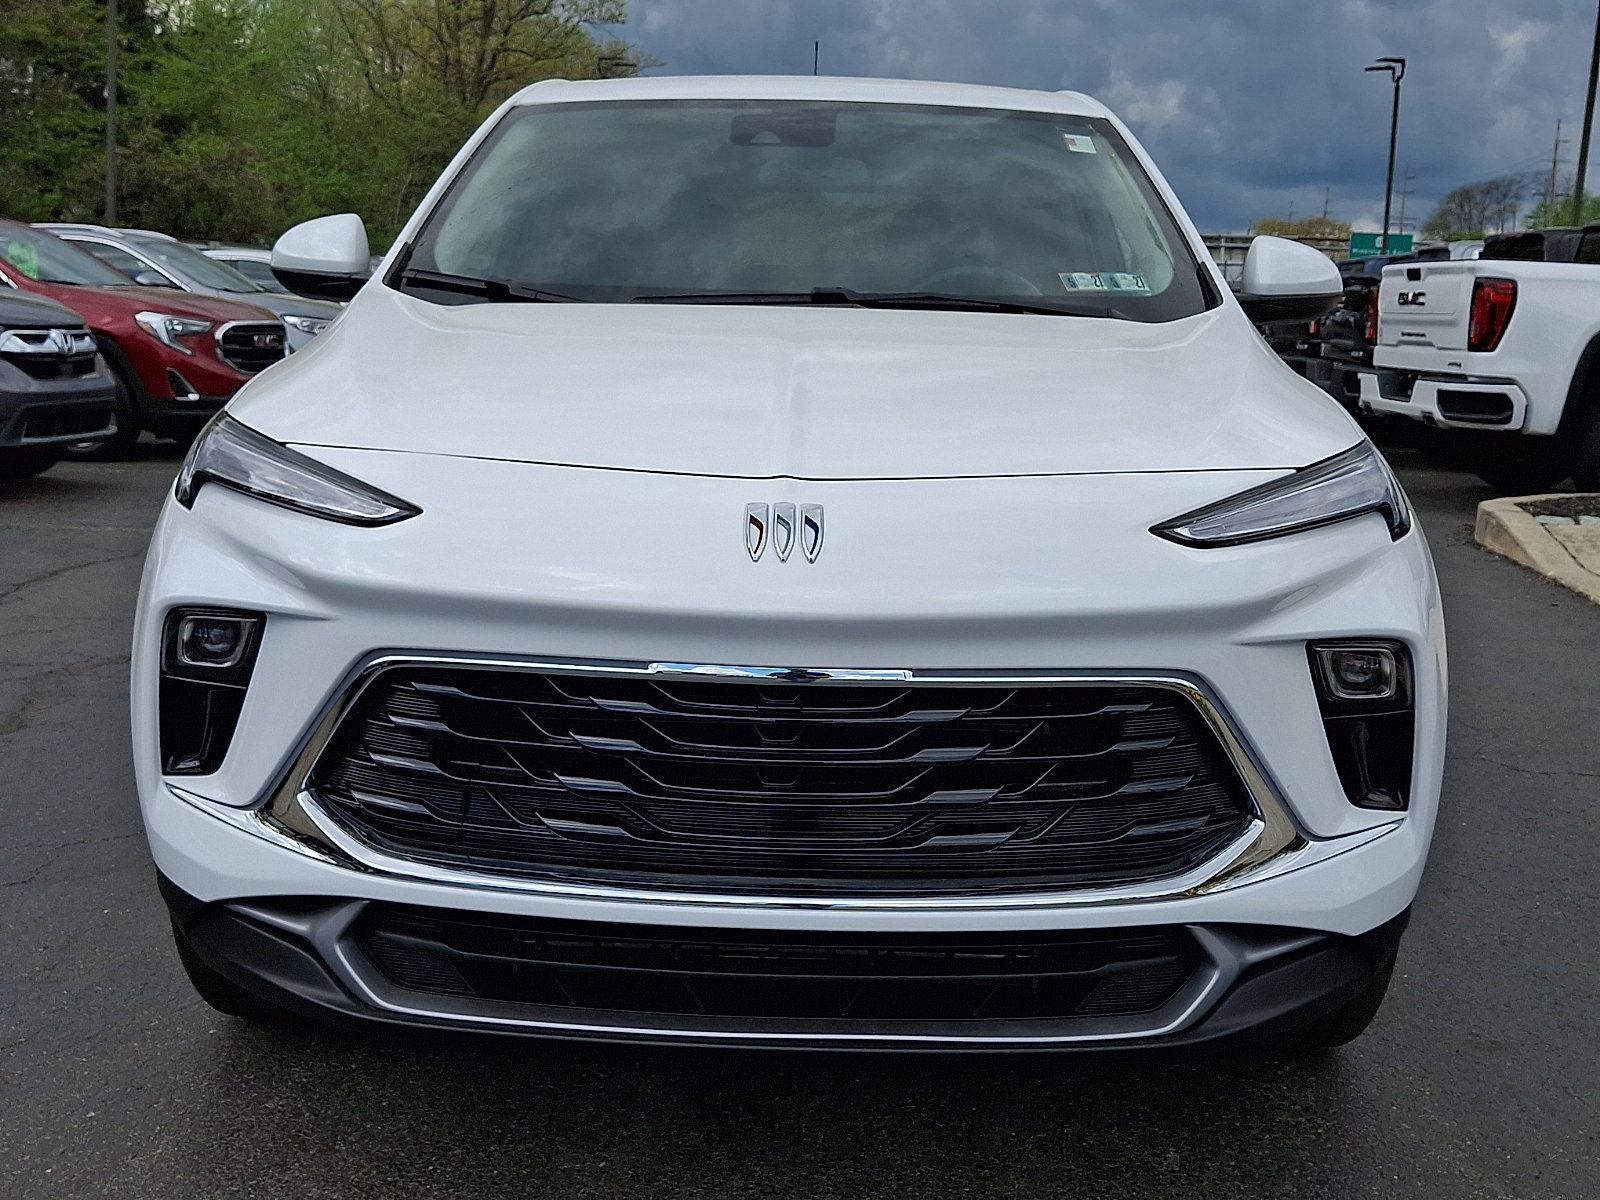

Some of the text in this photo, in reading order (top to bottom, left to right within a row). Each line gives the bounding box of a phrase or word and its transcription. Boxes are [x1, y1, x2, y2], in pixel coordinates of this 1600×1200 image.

[1091, 274, 1104, 288] 21
[1132, 275, 1145, 289] 21
[1398, 291, 1426, 306] GMC
